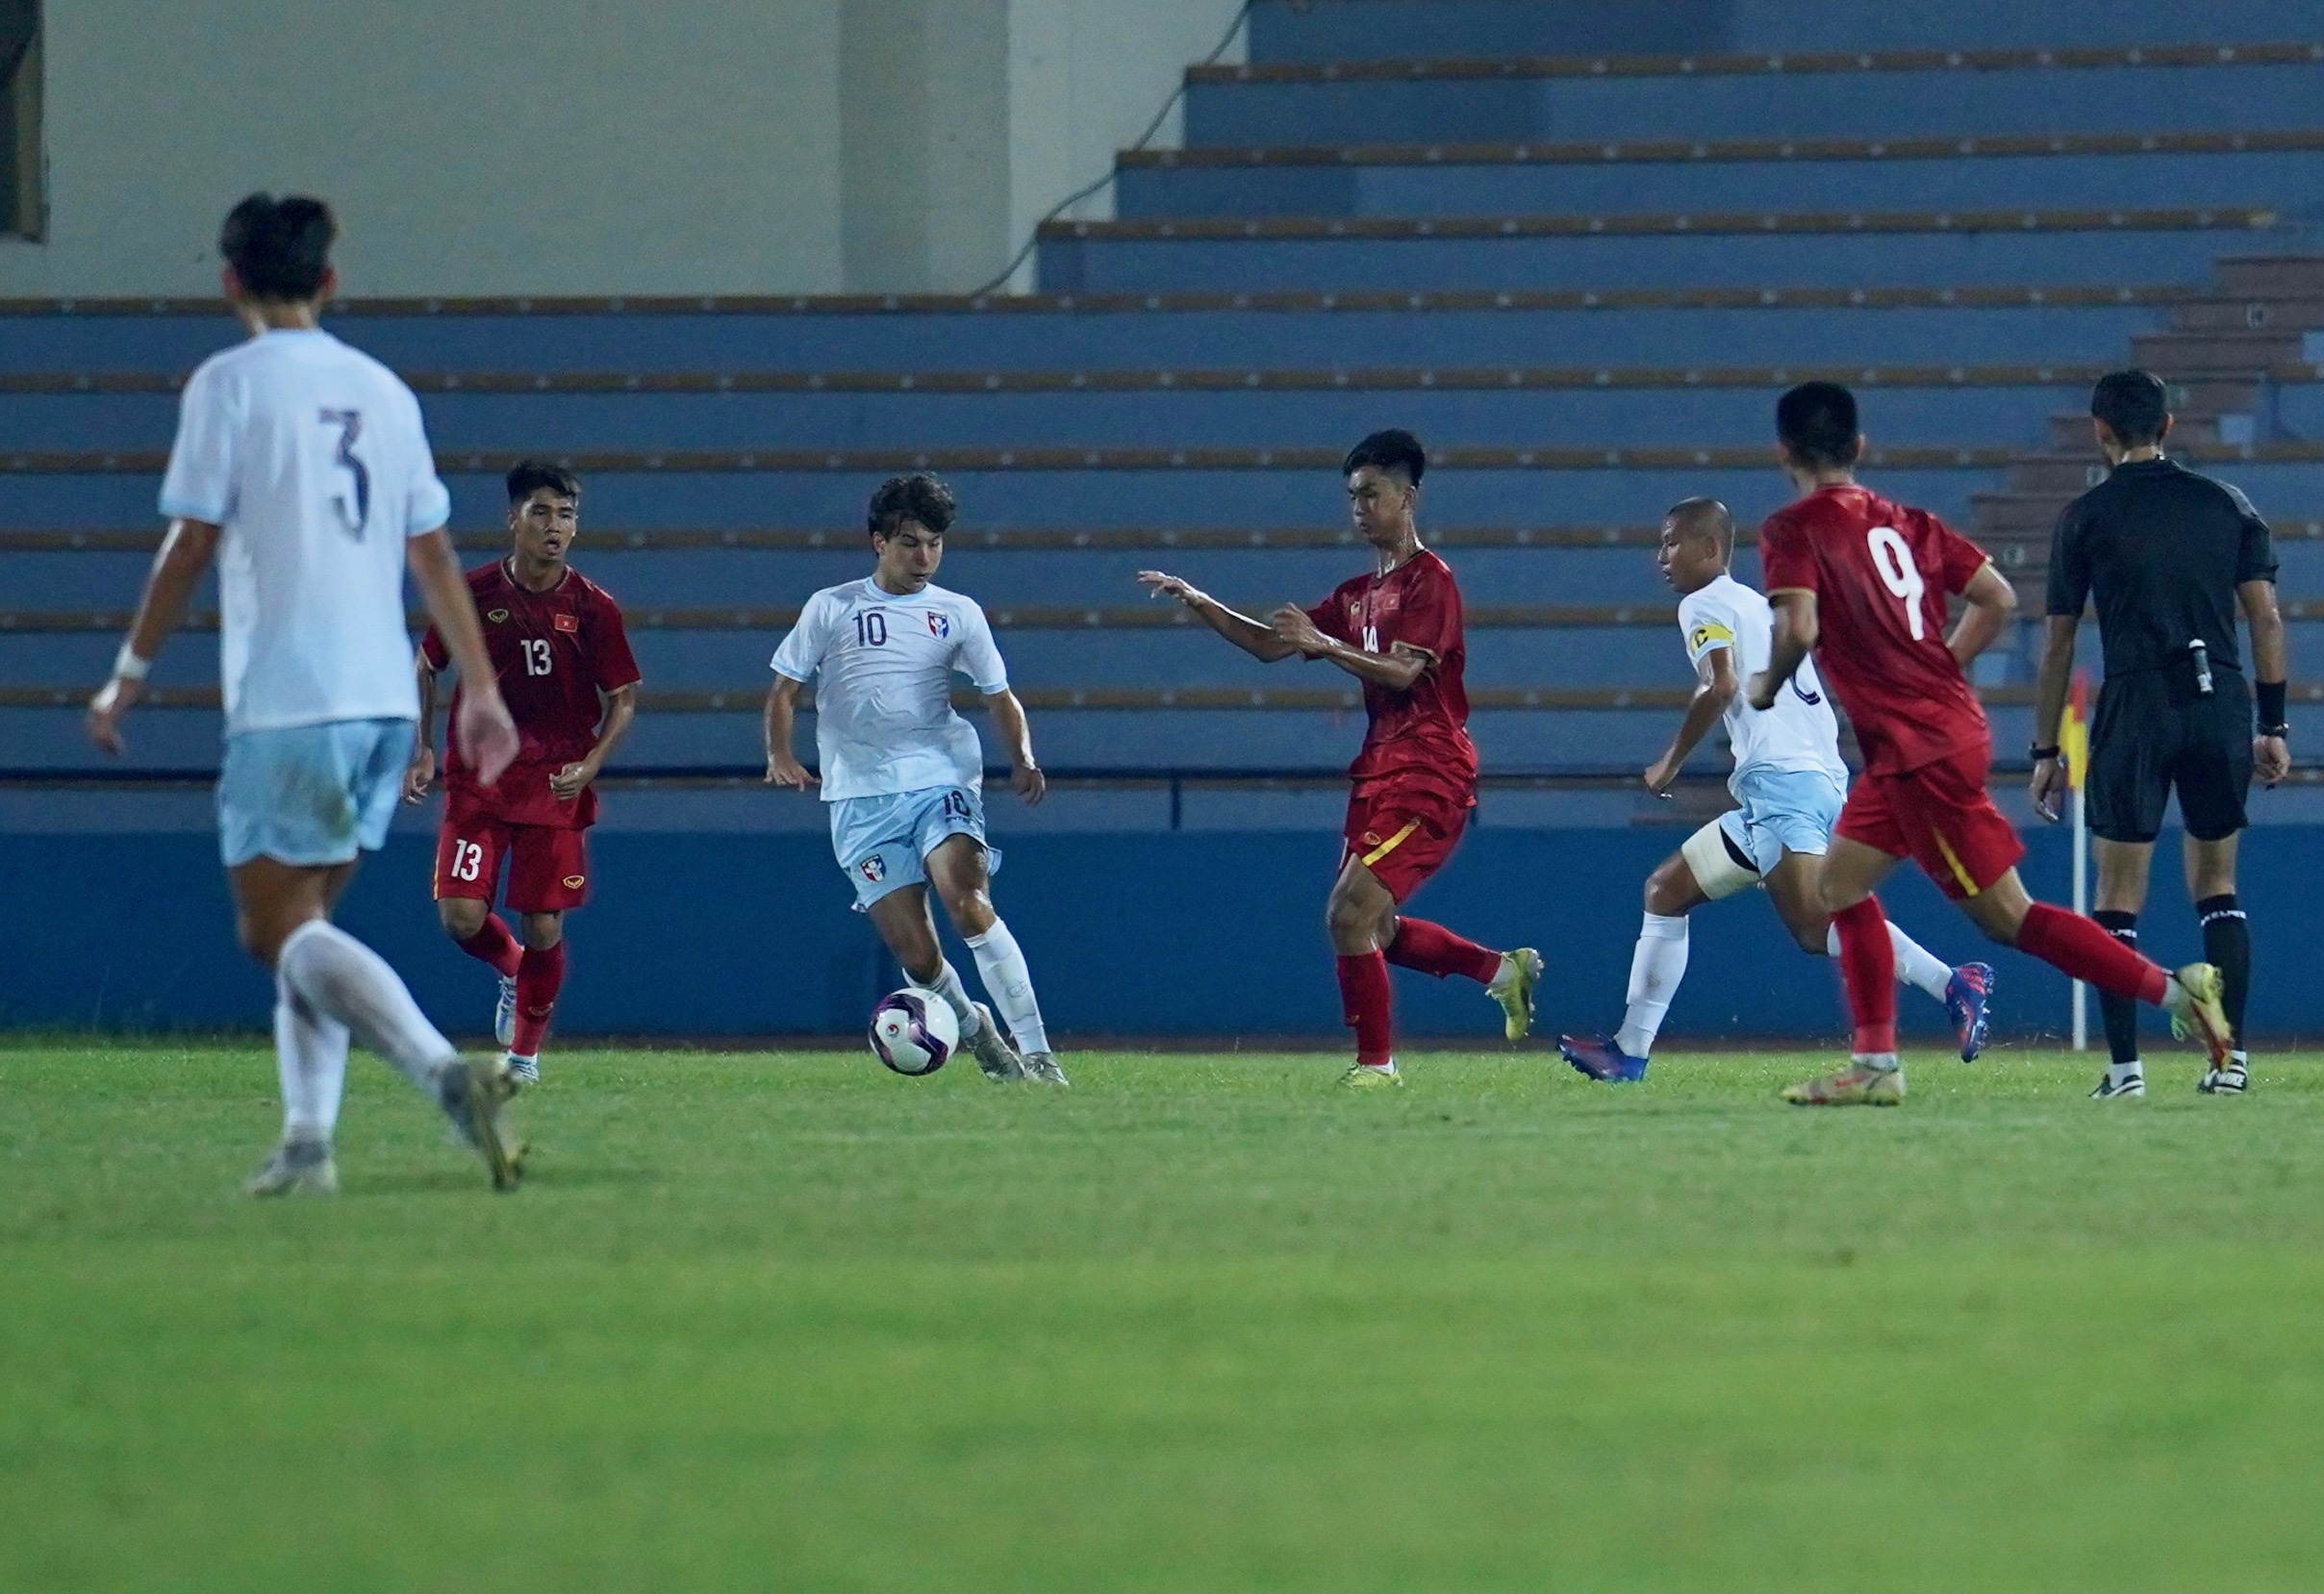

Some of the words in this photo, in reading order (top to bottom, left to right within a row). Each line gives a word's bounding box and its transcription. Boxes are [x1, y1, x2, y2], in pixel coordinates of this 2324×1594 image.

[317, 408, 370, 544] 3
[1867, 526, 1925, 641] 9
[852, 610, 887, 646] 10
[1362, 625, 1379, 653] 14
[1695, 628, 1708, 648] C
[520, 639, 552, 675] 13
[943, 790, 971, 817] 10
[451, 838, 483, 881] 13
